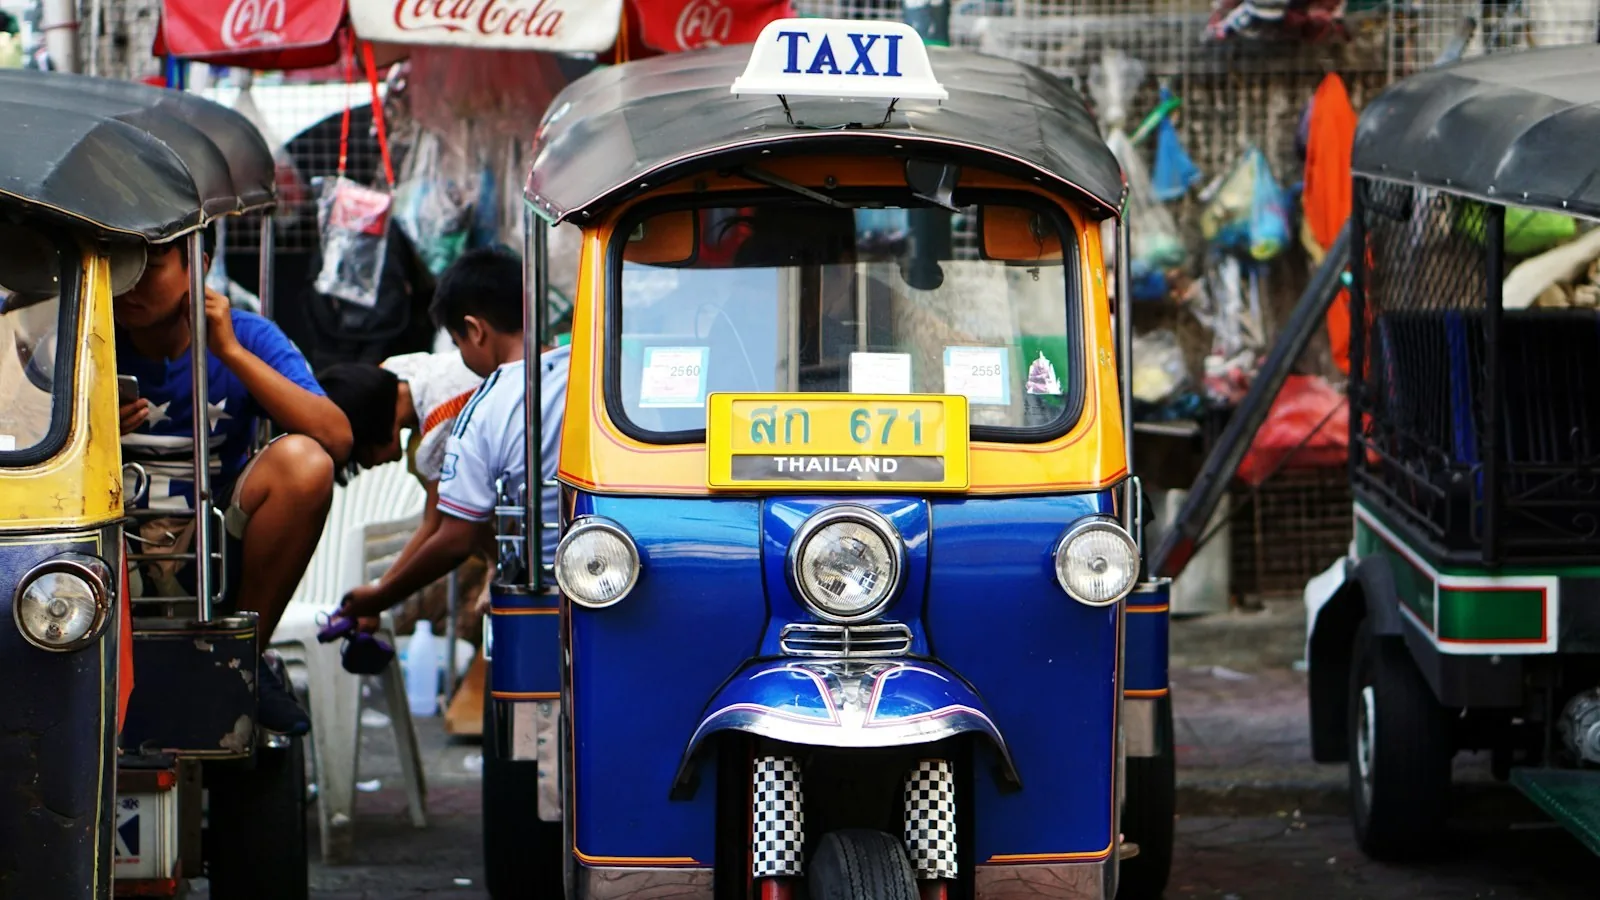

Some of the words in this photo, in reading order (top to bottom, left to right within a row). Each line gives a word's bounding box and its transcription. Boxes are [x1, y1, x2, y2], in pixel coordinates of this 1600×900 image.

[776, 31, 903, 77] TAXI
[670, 365, 701, 377] 2560
[971, 364, 1001, 377] 2558
[750, 405, 810, 444] สก
[849, 408, 924, 445] 671
[773, 456, 898, 473] THAILAND
